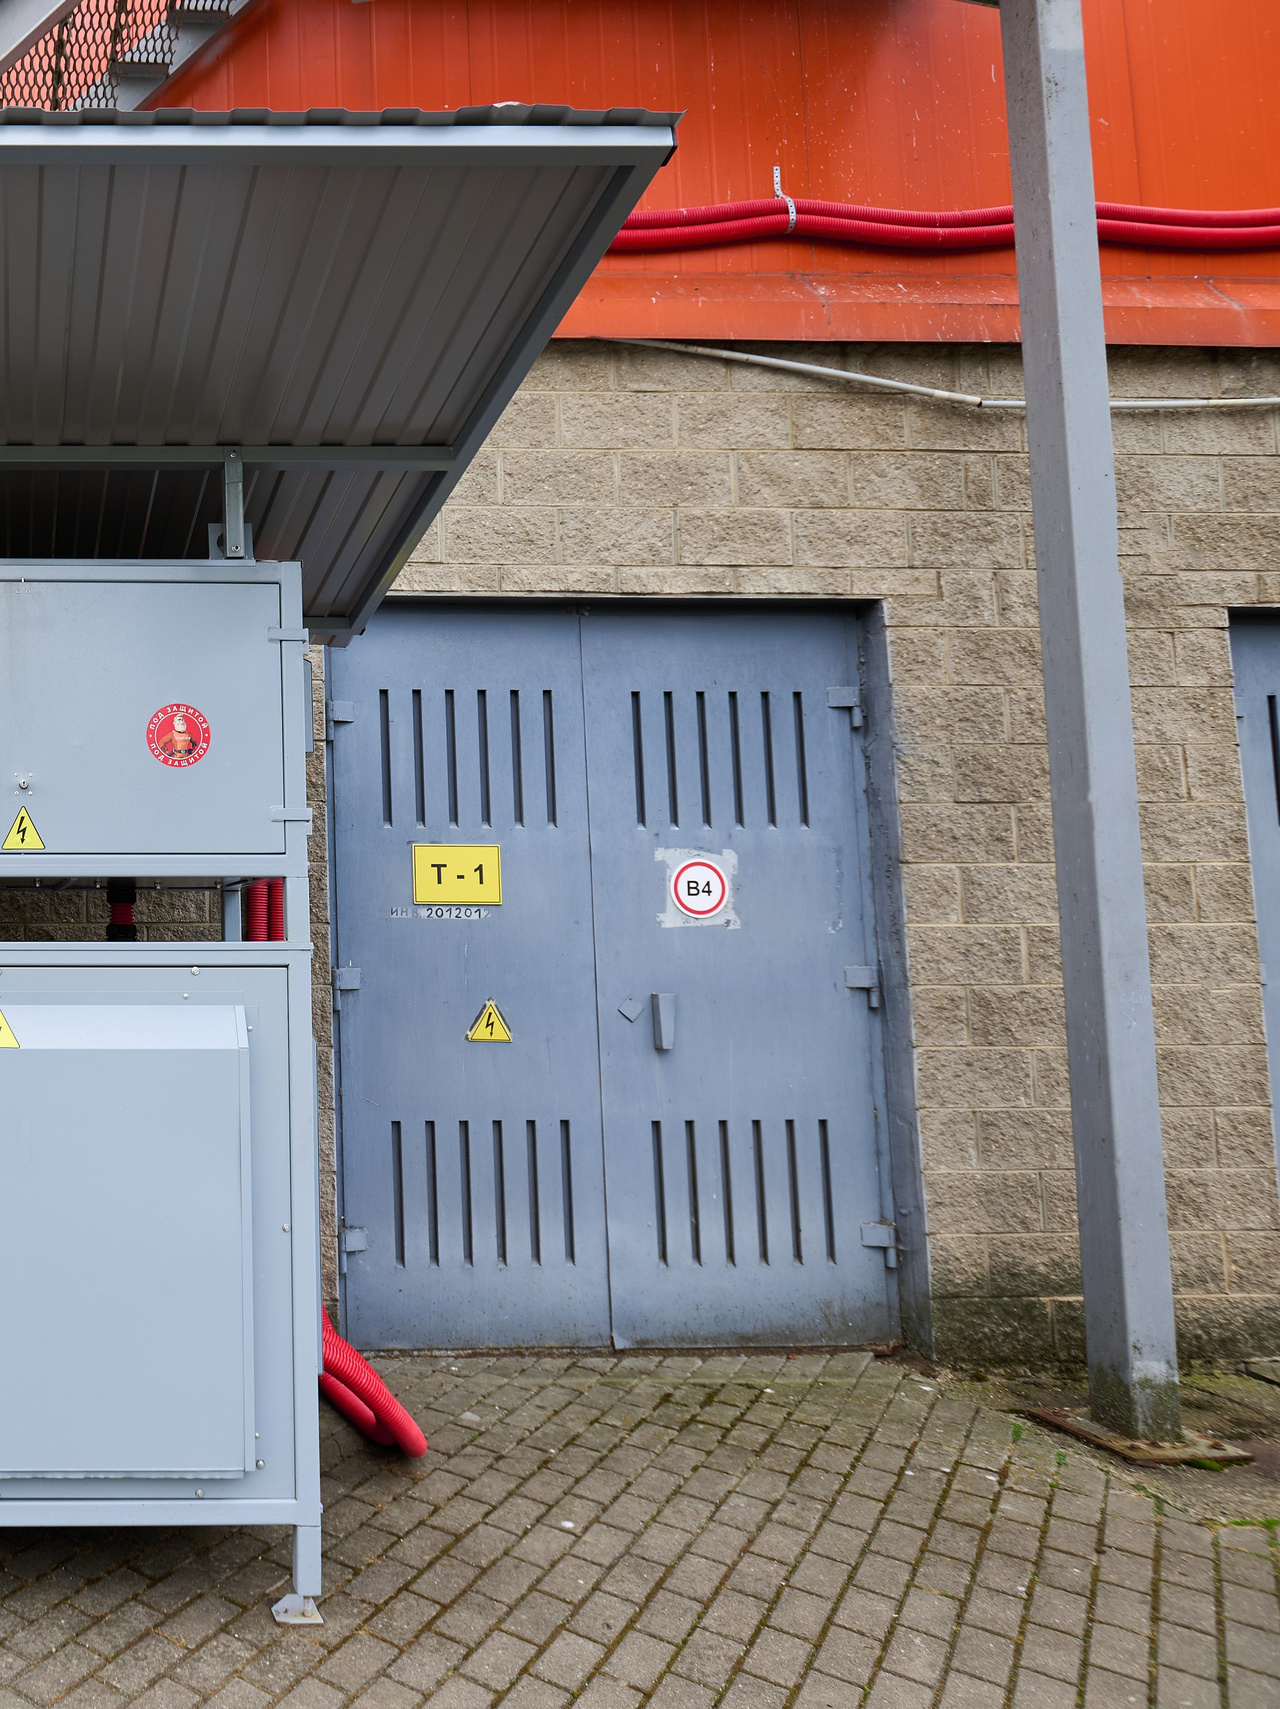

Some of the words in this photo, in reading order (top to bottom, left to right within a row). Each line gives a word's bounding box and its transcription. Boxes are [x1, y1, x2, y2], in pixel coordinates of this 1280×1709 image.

[149, 712, 165, 730] ПОД
[166, 705, 209, 729] ЗАЩИТОЙ
[150, 743, 165, 762] ПОД
[167, 742, 208, 767] ЗАЩИТОЙ
[686, 880, 713, 897] В4
